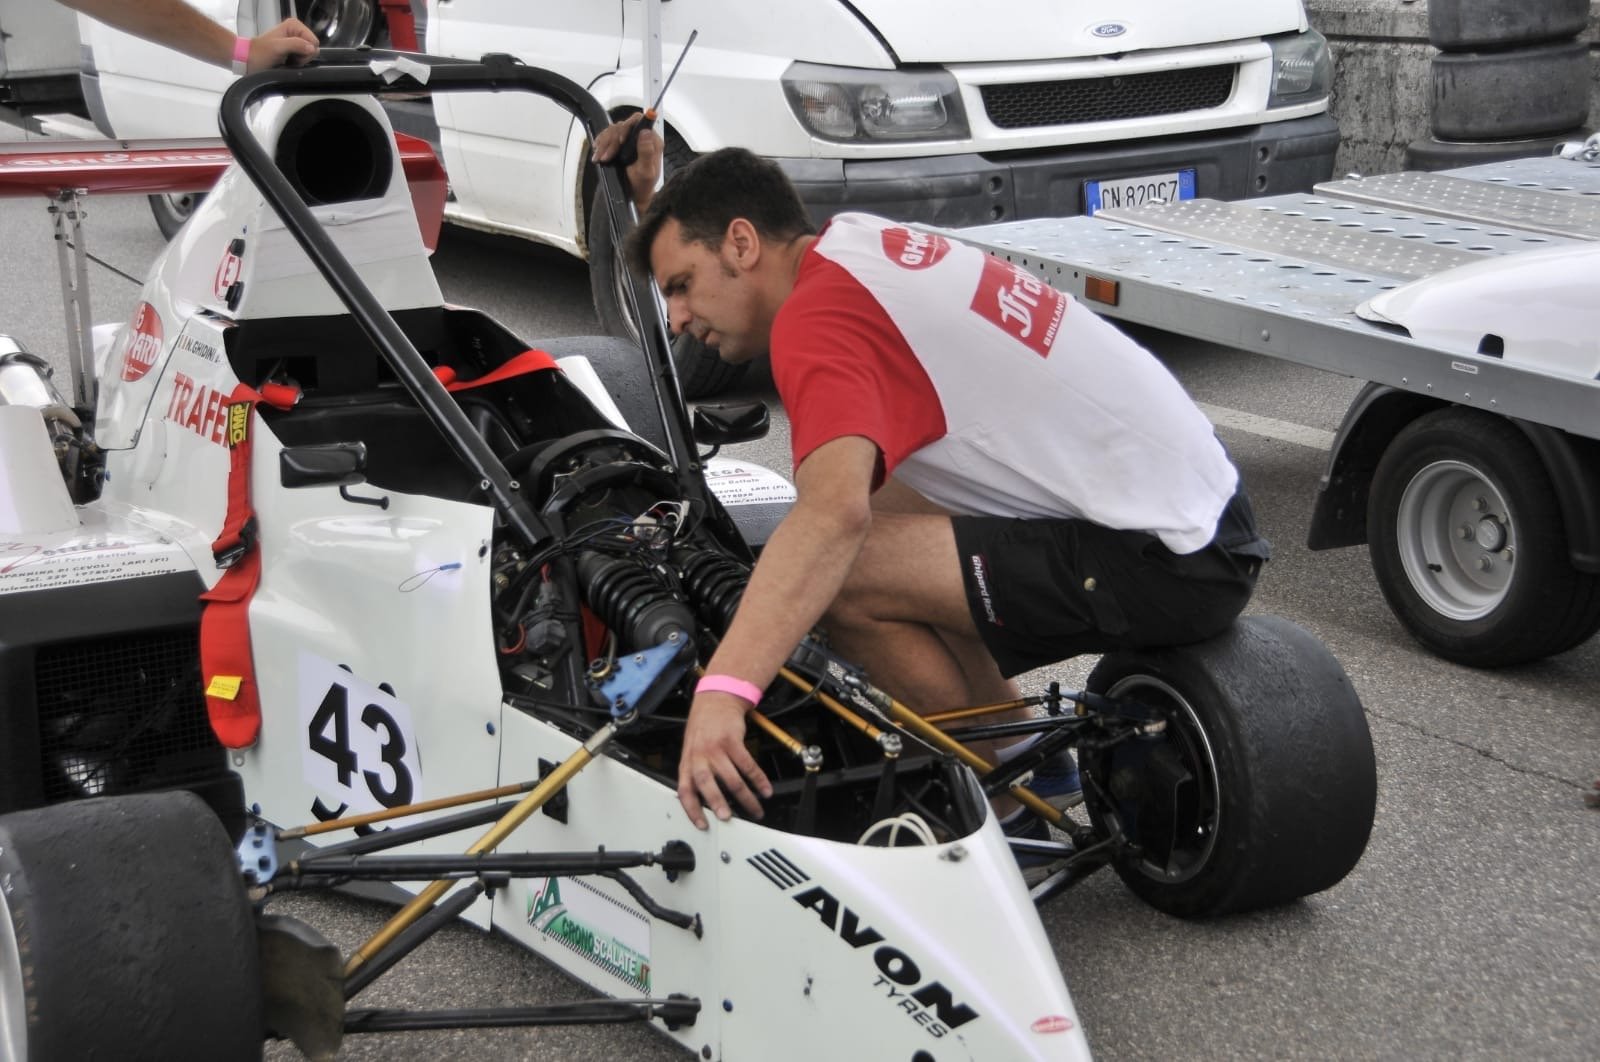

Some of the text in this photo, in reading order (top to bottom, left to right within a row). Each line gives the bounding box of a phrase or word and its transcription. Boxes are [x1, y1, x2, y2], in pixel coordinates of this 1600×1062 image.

[1042, 293, 1067, 348] BRILLANT
[168, 371, 229, 449] TRAFE
[232, 404, 246, 444] OMP
[308, 680, 414, 810] 43
[791, 885, 981, 1030] AVON
[872, 974, 948, 1039] TYRES
